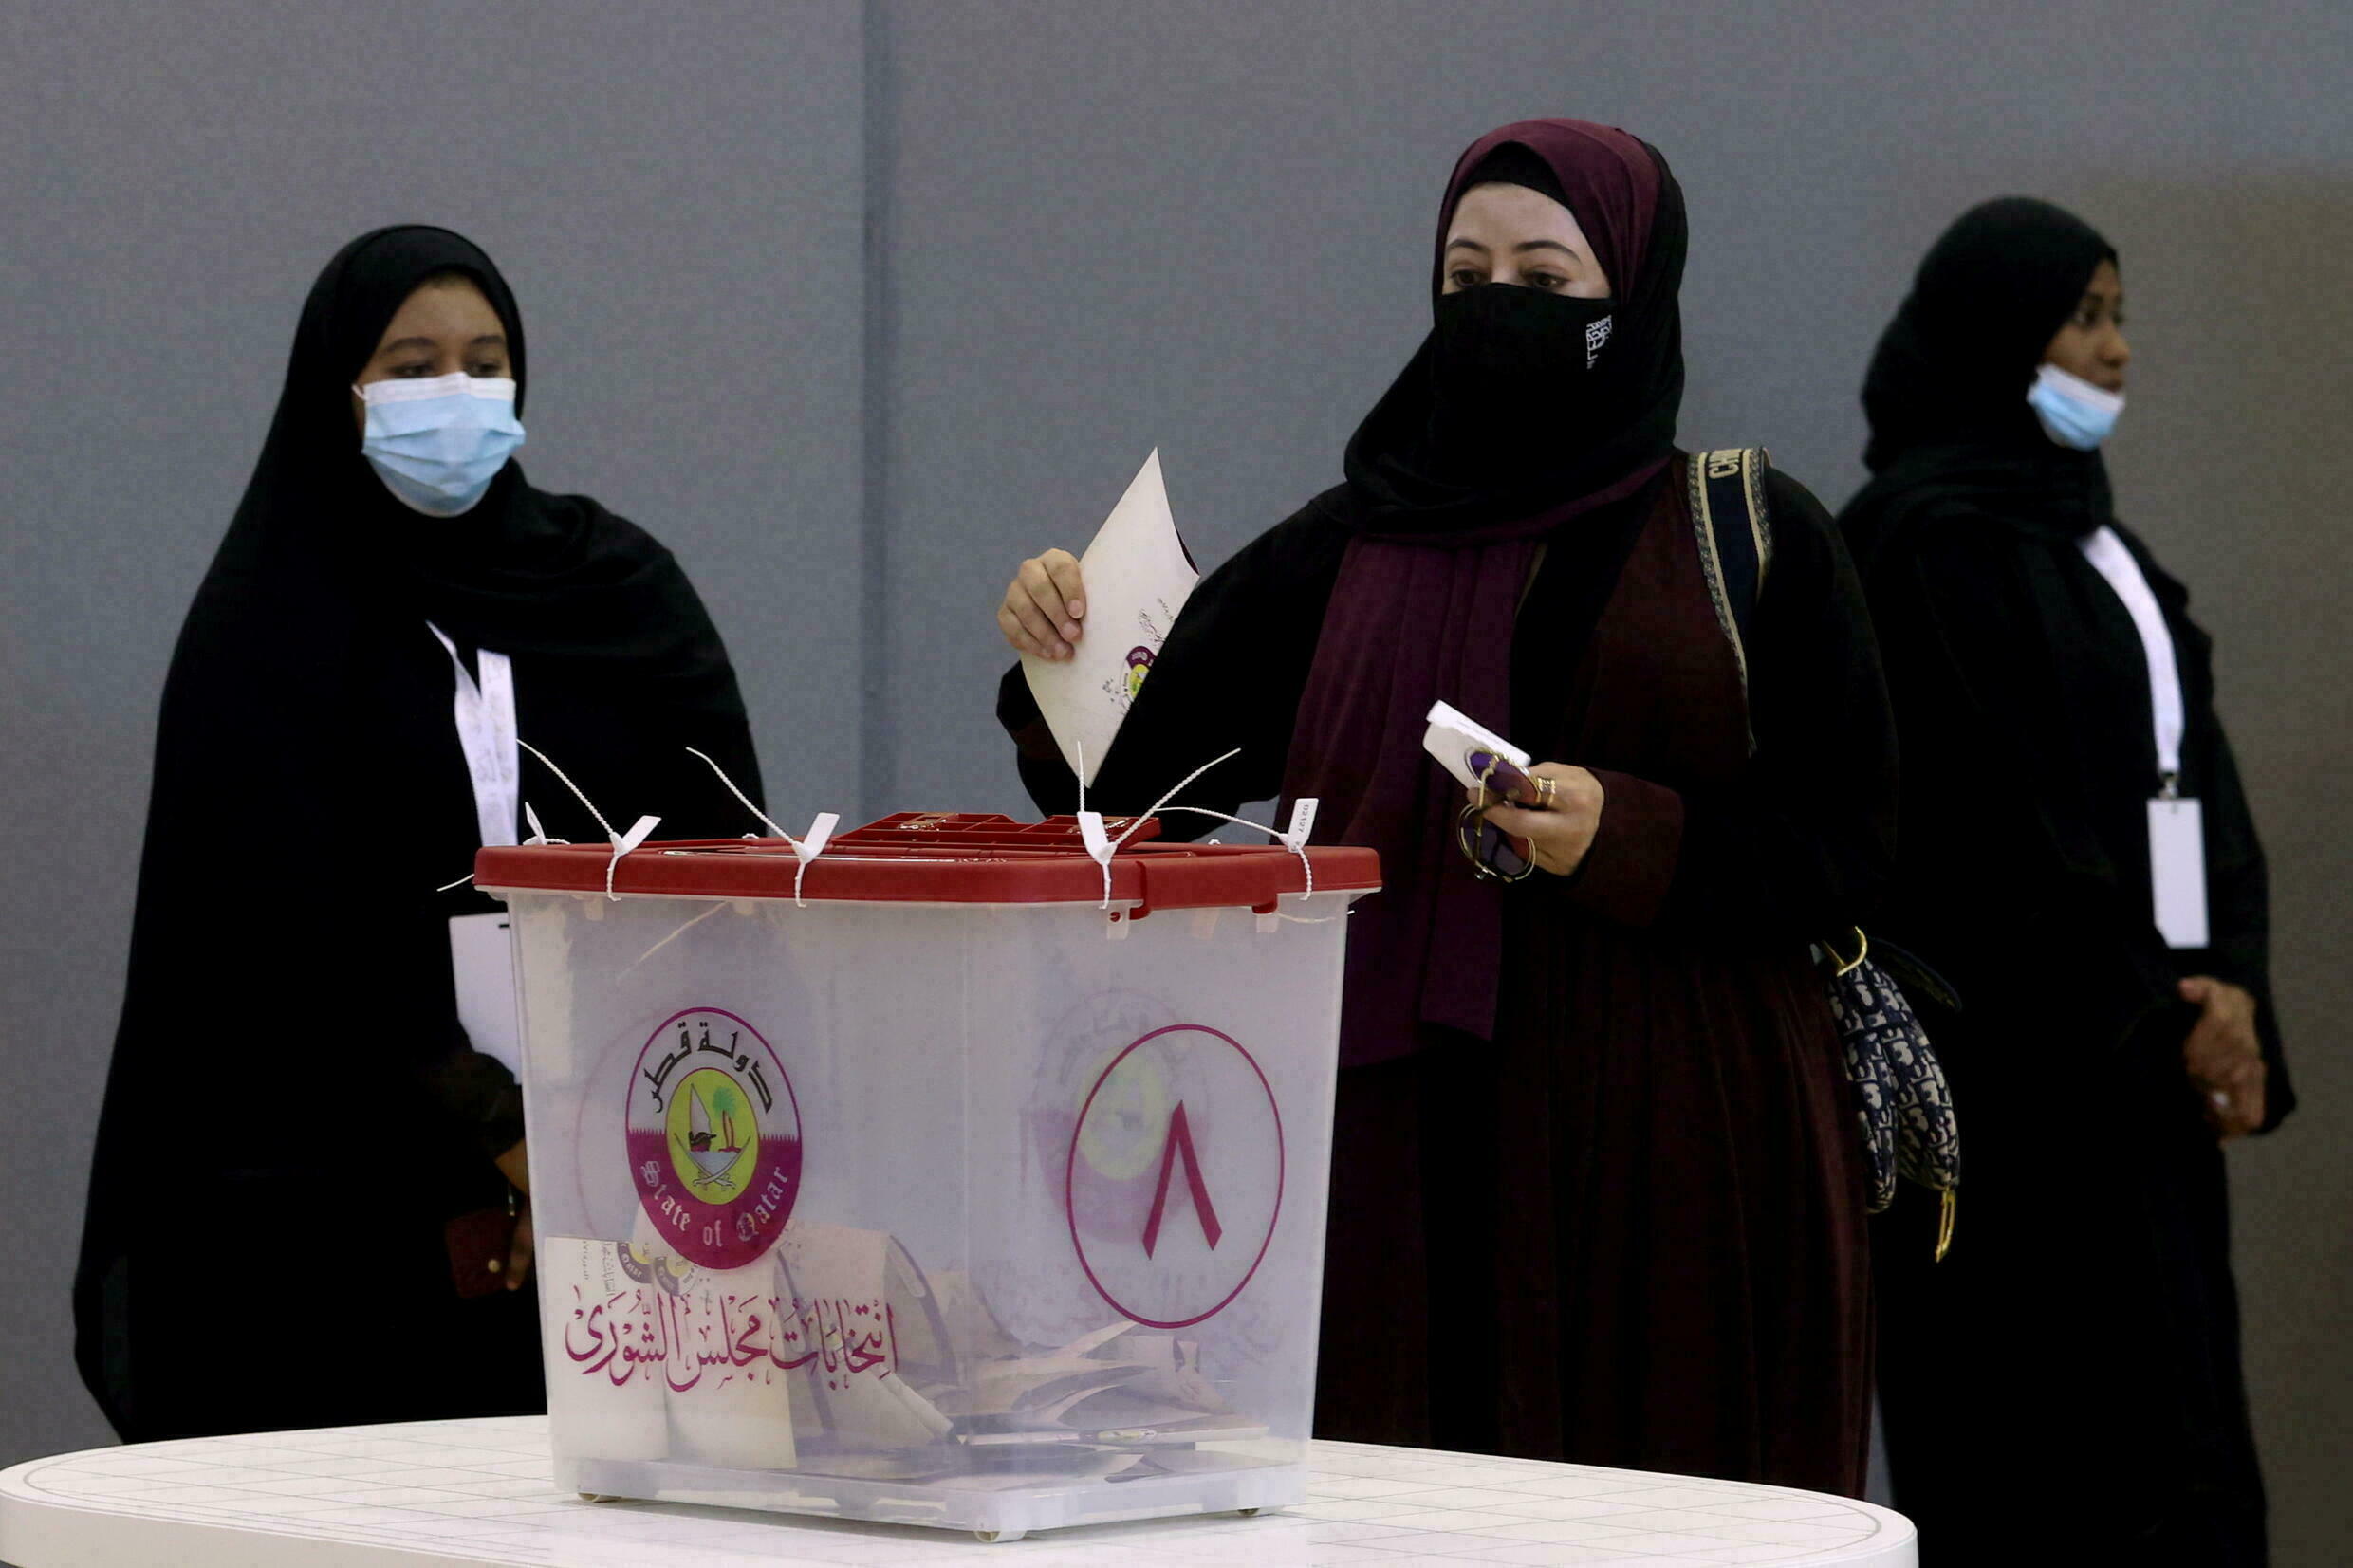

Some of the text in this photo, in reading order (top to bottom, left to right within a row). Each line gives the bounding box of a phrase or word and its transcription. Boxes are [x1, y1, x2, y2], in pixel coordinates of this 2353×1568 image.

[643, 1021, 773, 1115] دولة قطر
[639, 1160, 788, 1248] State of Qatar
